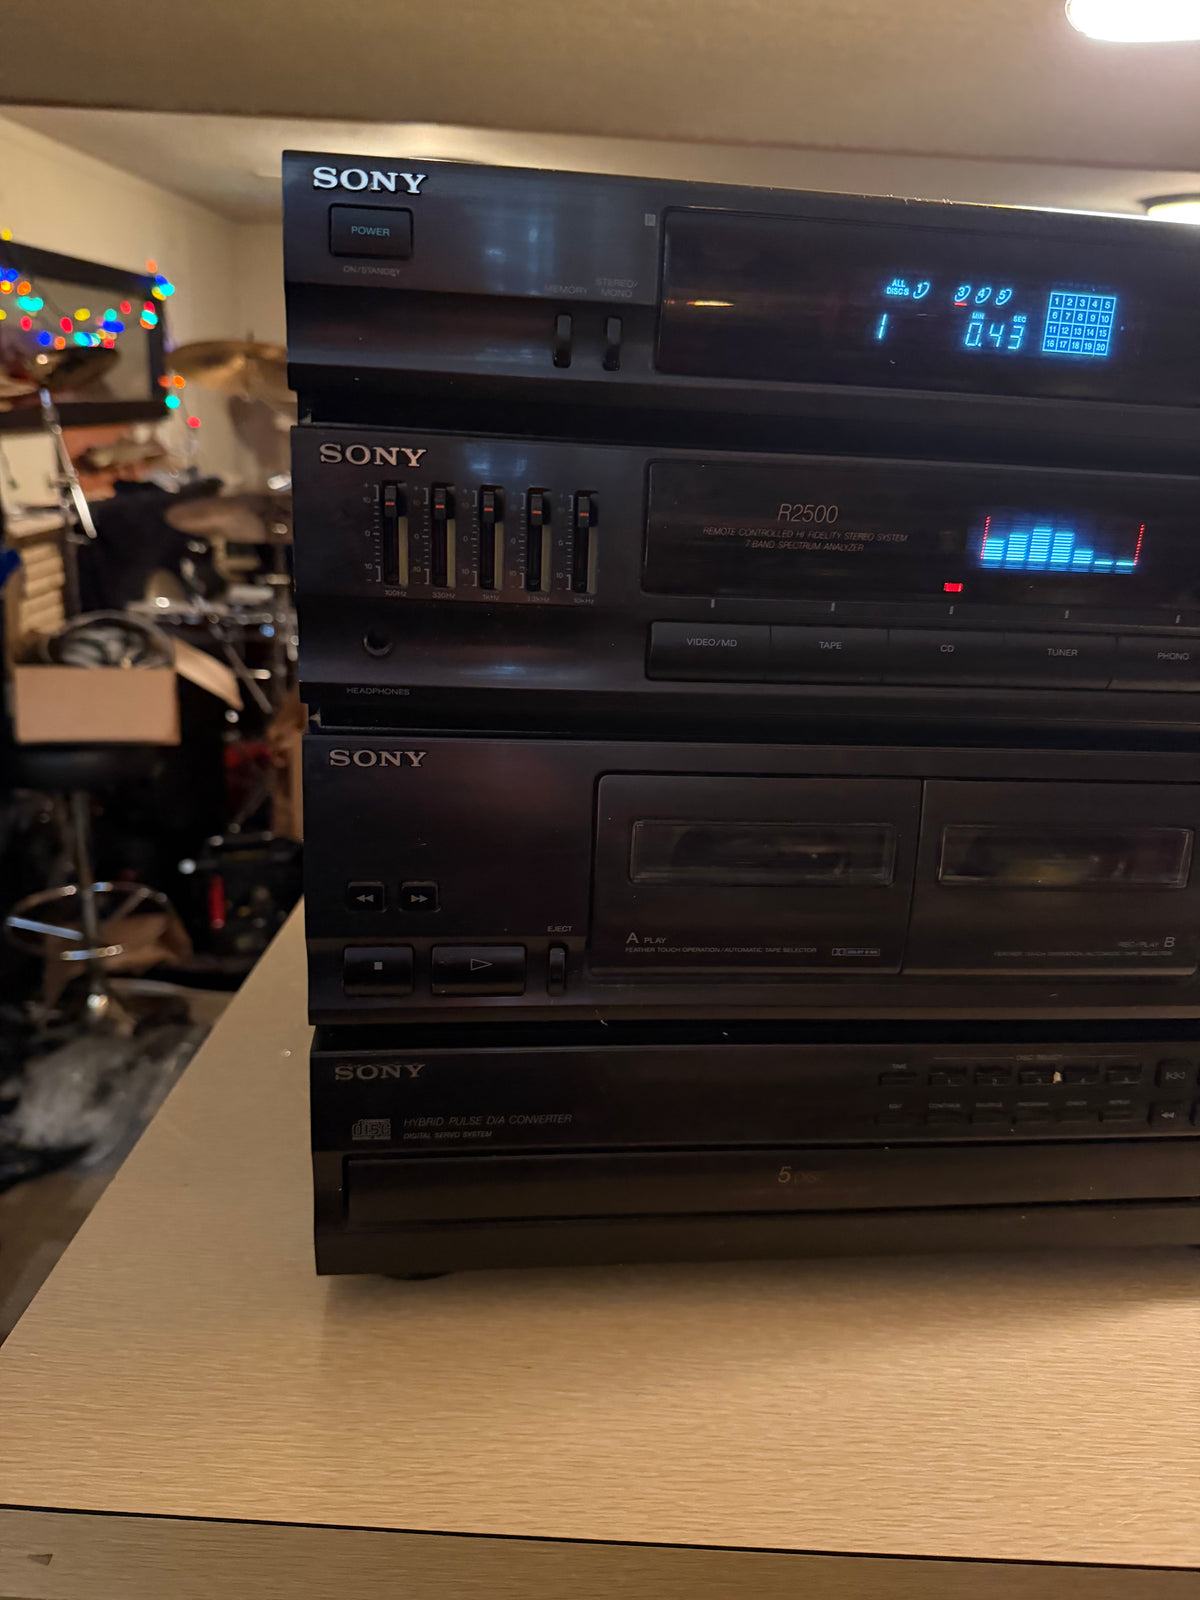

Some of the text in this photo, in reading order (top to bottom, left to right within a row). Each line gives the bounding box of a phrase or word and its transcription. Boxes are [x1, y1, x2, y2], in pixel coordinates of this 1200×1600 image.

[313, 166, 426, 194] SONY
[351, 225, 391, 237] POWER
[891, 279, 906, 288] ALL
[601, 288, 633, 298] MONO
[886, 287, 910, 296] DISCS
[1067, 298, 1073, 307] 2
[1079, 299, 1086, 307] 3
[1091, 300, 1098, 308] 4
[1104, 301, 1111, 309] 5
[972, 312, 986, 321] MIN
[1013, 316, 1028, 324] SEC
[1052, 311, 1110, 323] 6 7 8 9 10
[1049, 326, 1107, 337] 11 12 13 14 15
[1046, 340, 1106, 351] 16 17 18 19 20
[319, 443, 427, 467] SONY
[777, 503, 839, 524] R2500
[702, 527, 736, 537] REMOTE
[738, 528, 793, 538] CONTROLLED
[808, 531, 841, 540] FIDELITY
[844, 532, 875, 542] STEREO
[877, 533, 909, 542] SYSTEM
[777, 541, 822, 550] SPECTRUM
[824, 542, 865, 551] ANALYZER
[686, 638, 738, 647] VIDEO/MD
[818, 641, 842, 650] TAPE
[940, 645, 955, 653] CD
[1047, 648, 1078, 657] TUNER
[1157, 652, 1189, 661] PHONO
[346, 687, 410, 697] HEADPHONES
[329, 749, 427, 767] SONY
[626, 932, 640, 944] A
[1163, 936, 1175, 948] B
[334, 1063, 426, 1080] SONY
[404, 1114, 573, 1126] HYBRID PULSE D/A CONVERTER
[778, 1165, 792, 1184] 5
